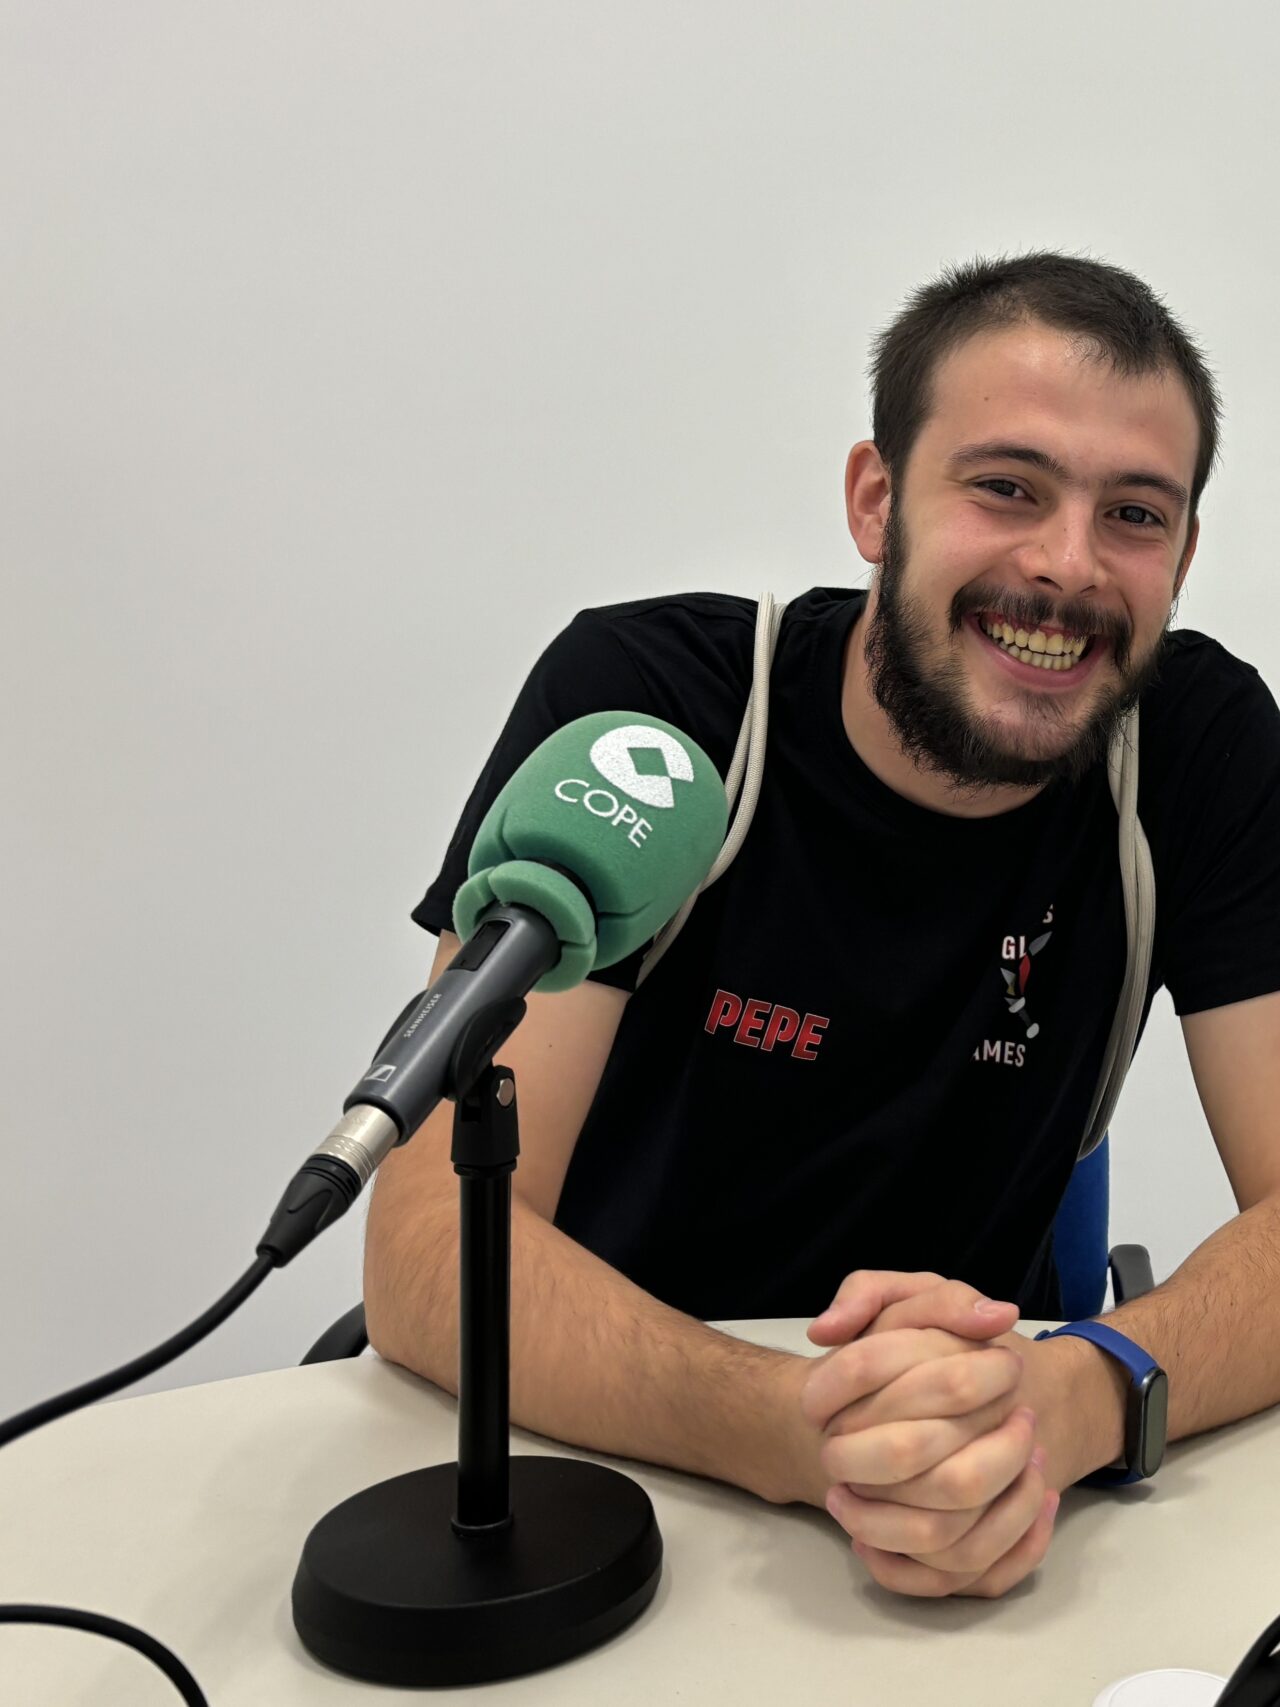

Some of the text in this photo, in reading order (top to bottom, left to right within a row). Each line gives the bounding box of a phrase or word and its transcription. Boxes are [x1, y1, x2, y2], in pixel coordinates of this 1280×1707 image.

[555, 778, 653, 848] COPE
[403, 993, 442, 1037] SENNHEISER
[704, 988, 830, 1060] PEPE
